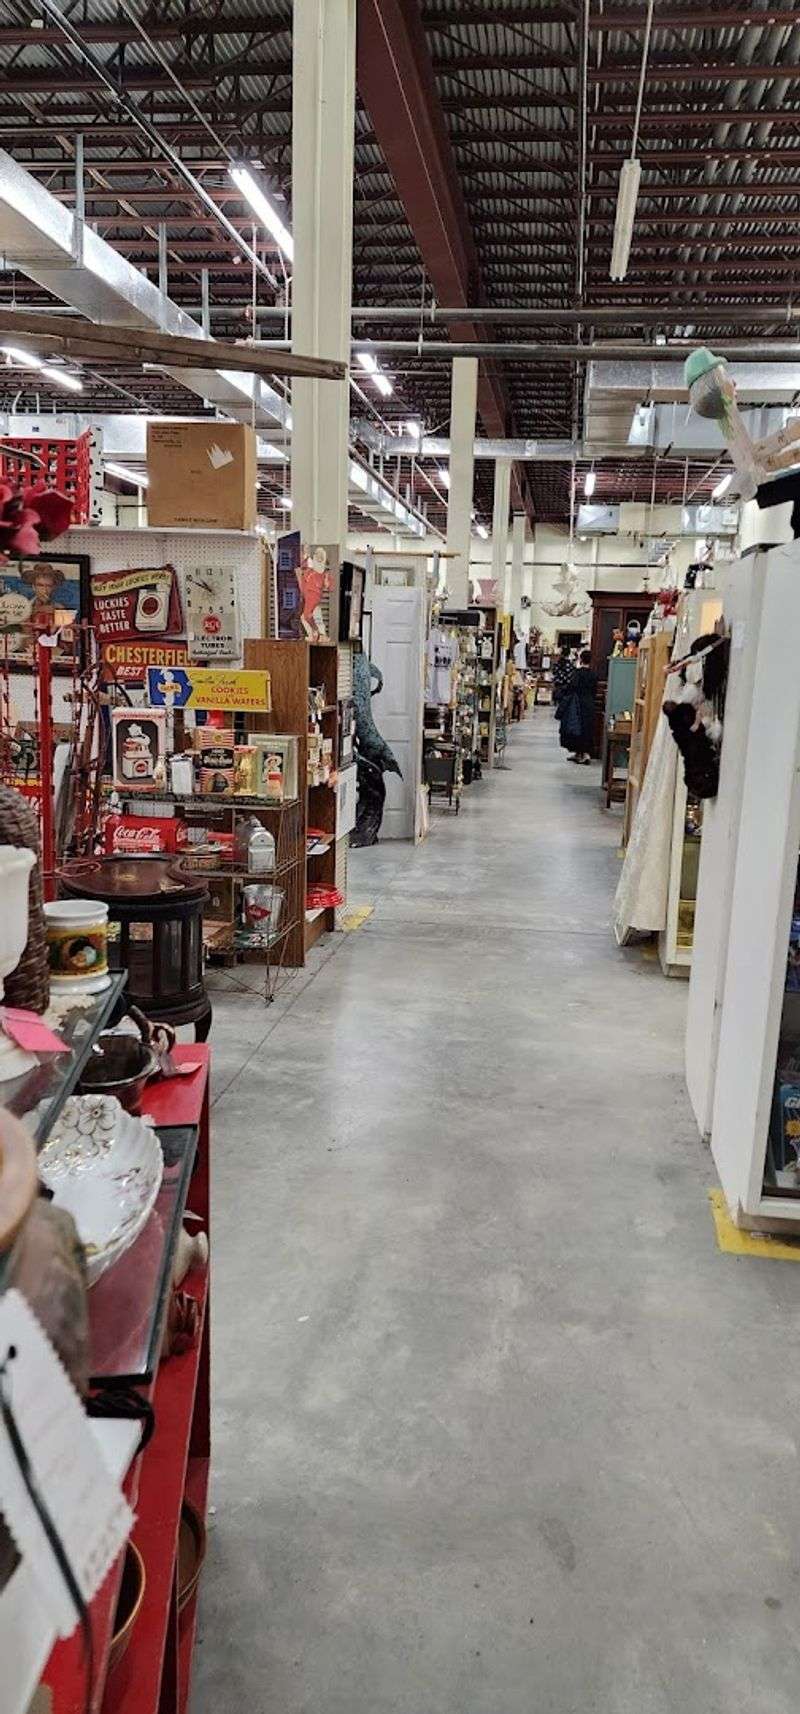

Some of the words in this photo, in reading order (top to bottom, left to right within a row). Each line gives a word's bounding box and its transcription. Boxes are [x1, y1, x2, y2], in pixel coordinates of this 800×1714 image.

[94, 596, 130, 610] LUCKIES
[100, 609, 127, 622] TASTE
[100, 620, 130, 634] BETTER
[115, 666, 144, 677] BEST
[210, 686, 249, 695] COOKIES
[195, 696, 231, 705] VANILLA
[232, 697, 266, 706] WAFERS
[113, 825, 161, 842] Coca-Cola
